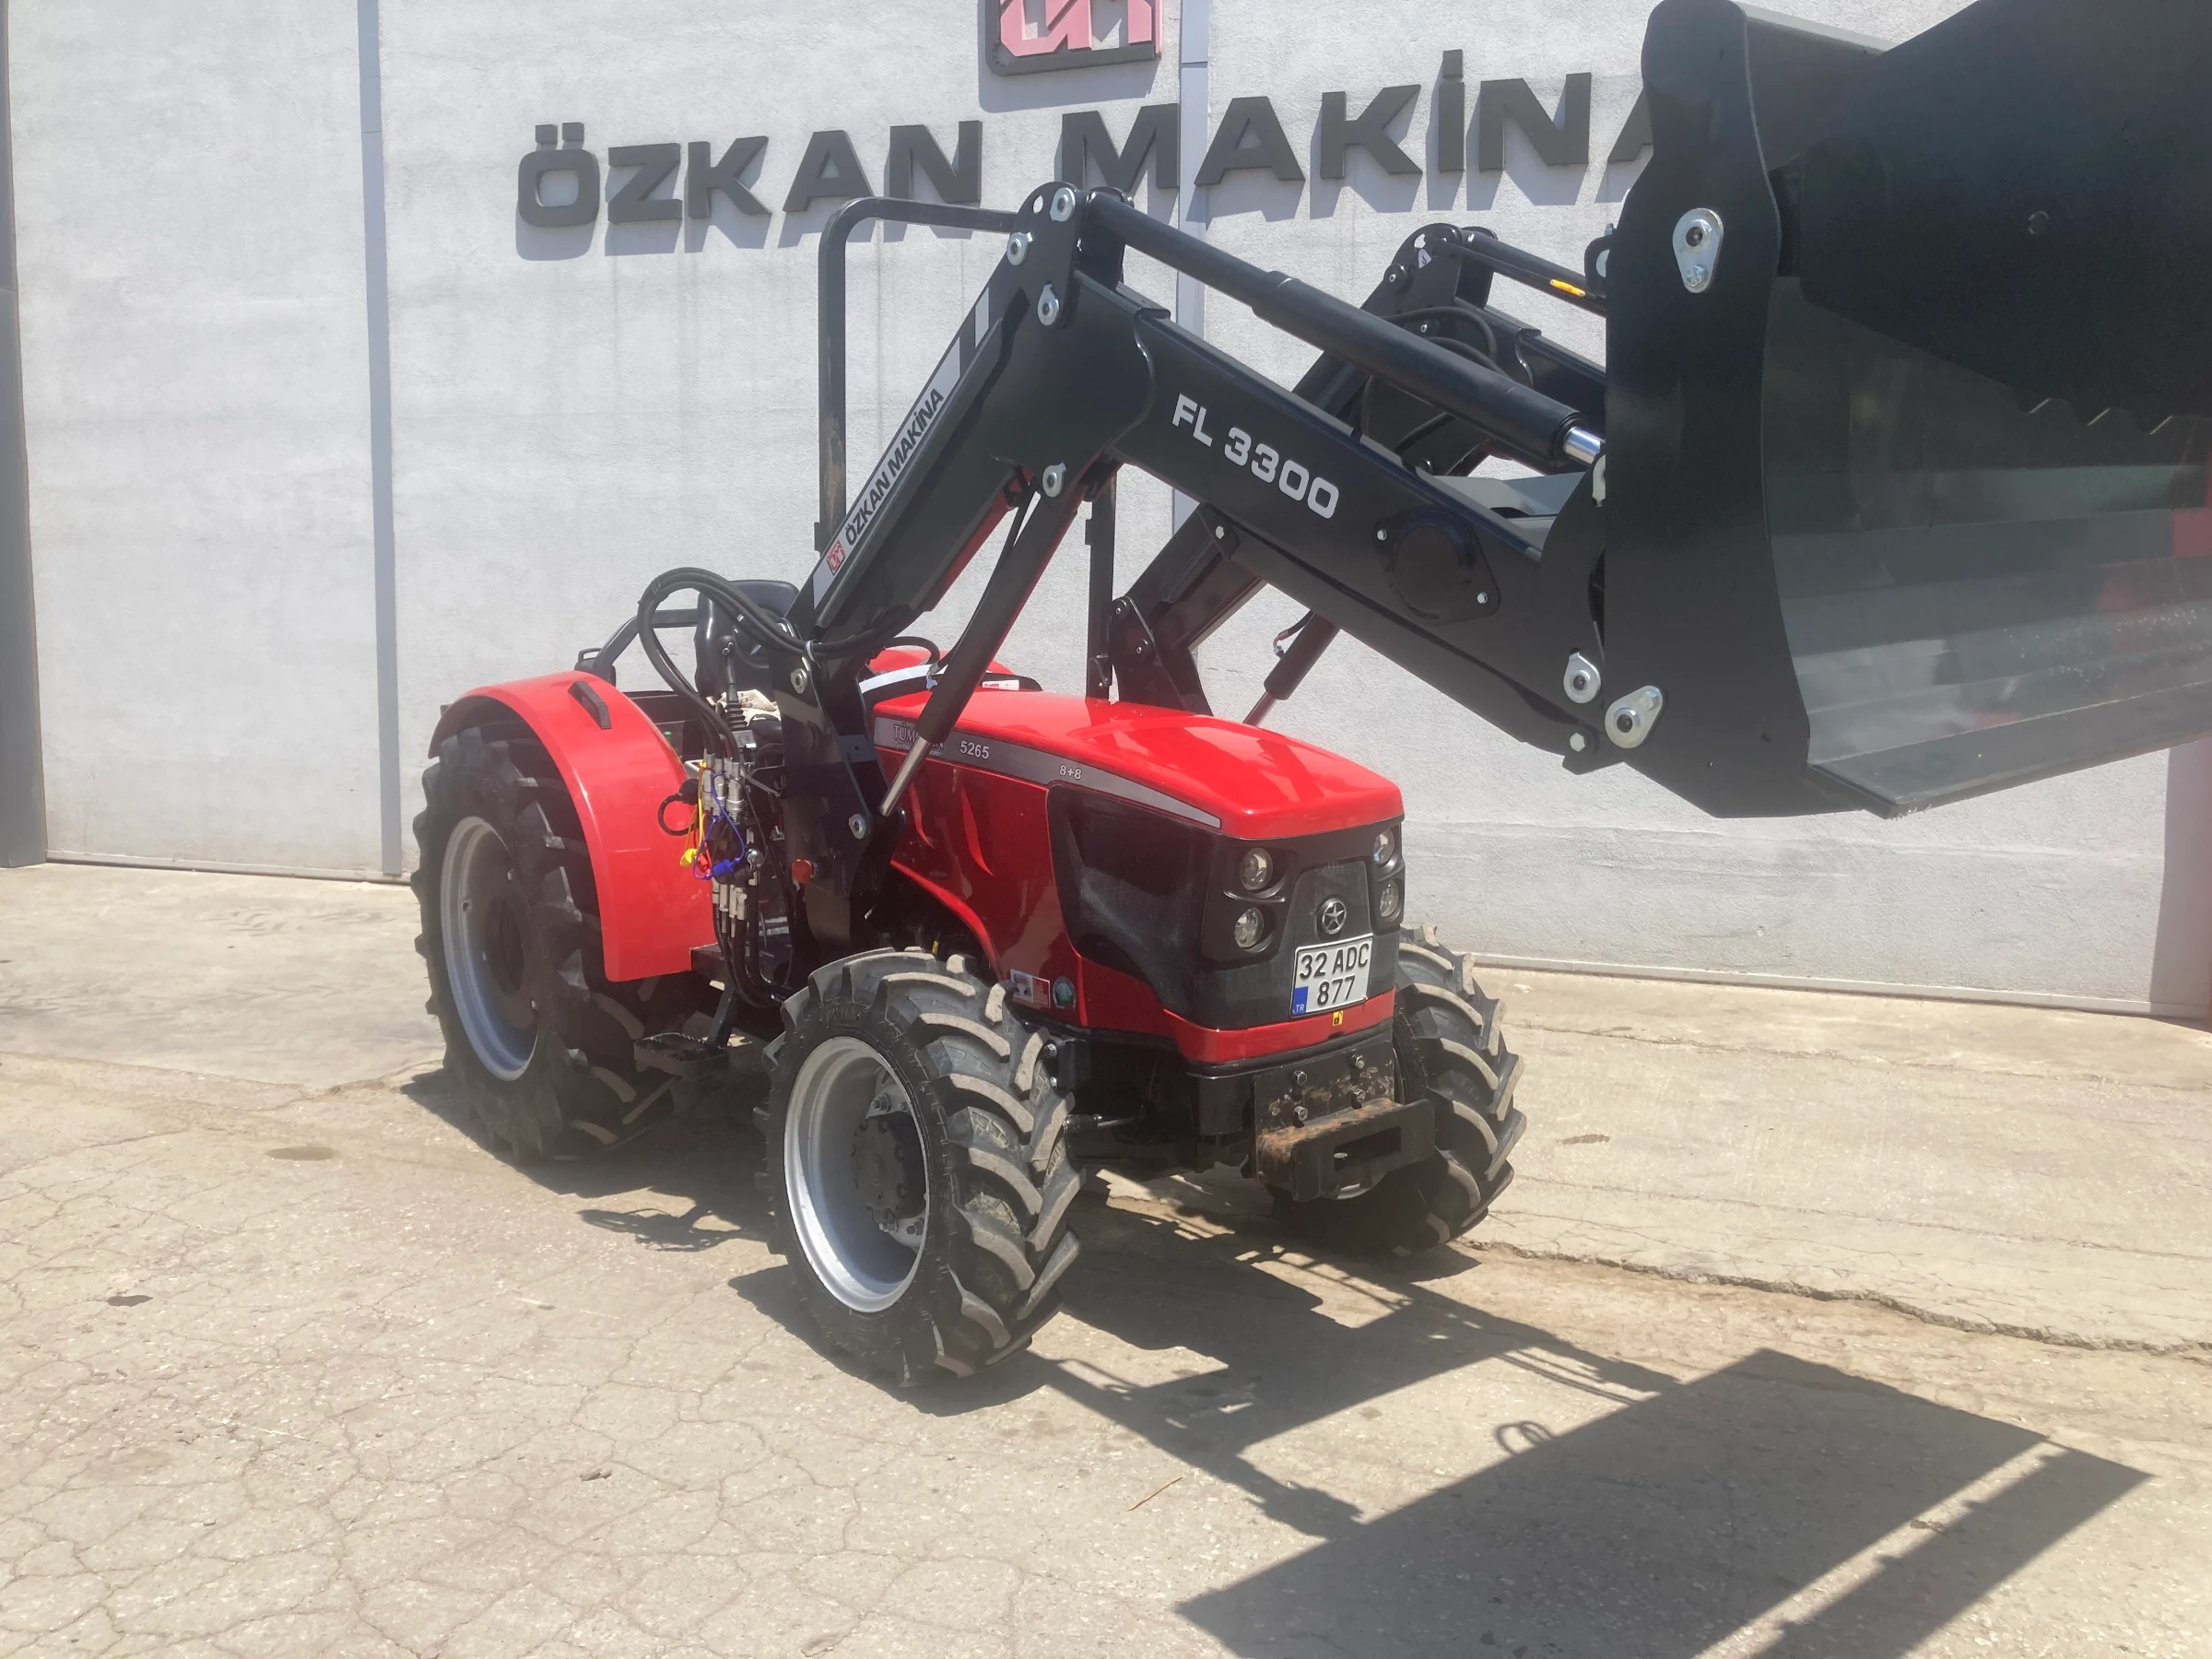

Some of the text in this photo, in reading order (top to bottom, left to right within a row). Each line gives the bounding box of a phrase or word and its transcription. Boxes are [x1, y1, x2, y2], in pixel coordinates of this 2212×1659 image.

[518, 122, 982, 228] ÖZKAN
[845, 388, 944, 546] ÖZKAN MAKİNA
[1172, 394, 1339, 519] FL 3300
[959, 740, 990, 759] 5265
[1059, 764, 1082, 780] 8+8
[1299, 943, 1370, 980] 32 ADC
[1316, 974, 1356, 1006] 877
[1295, 1003, 1305, 1013] TR
